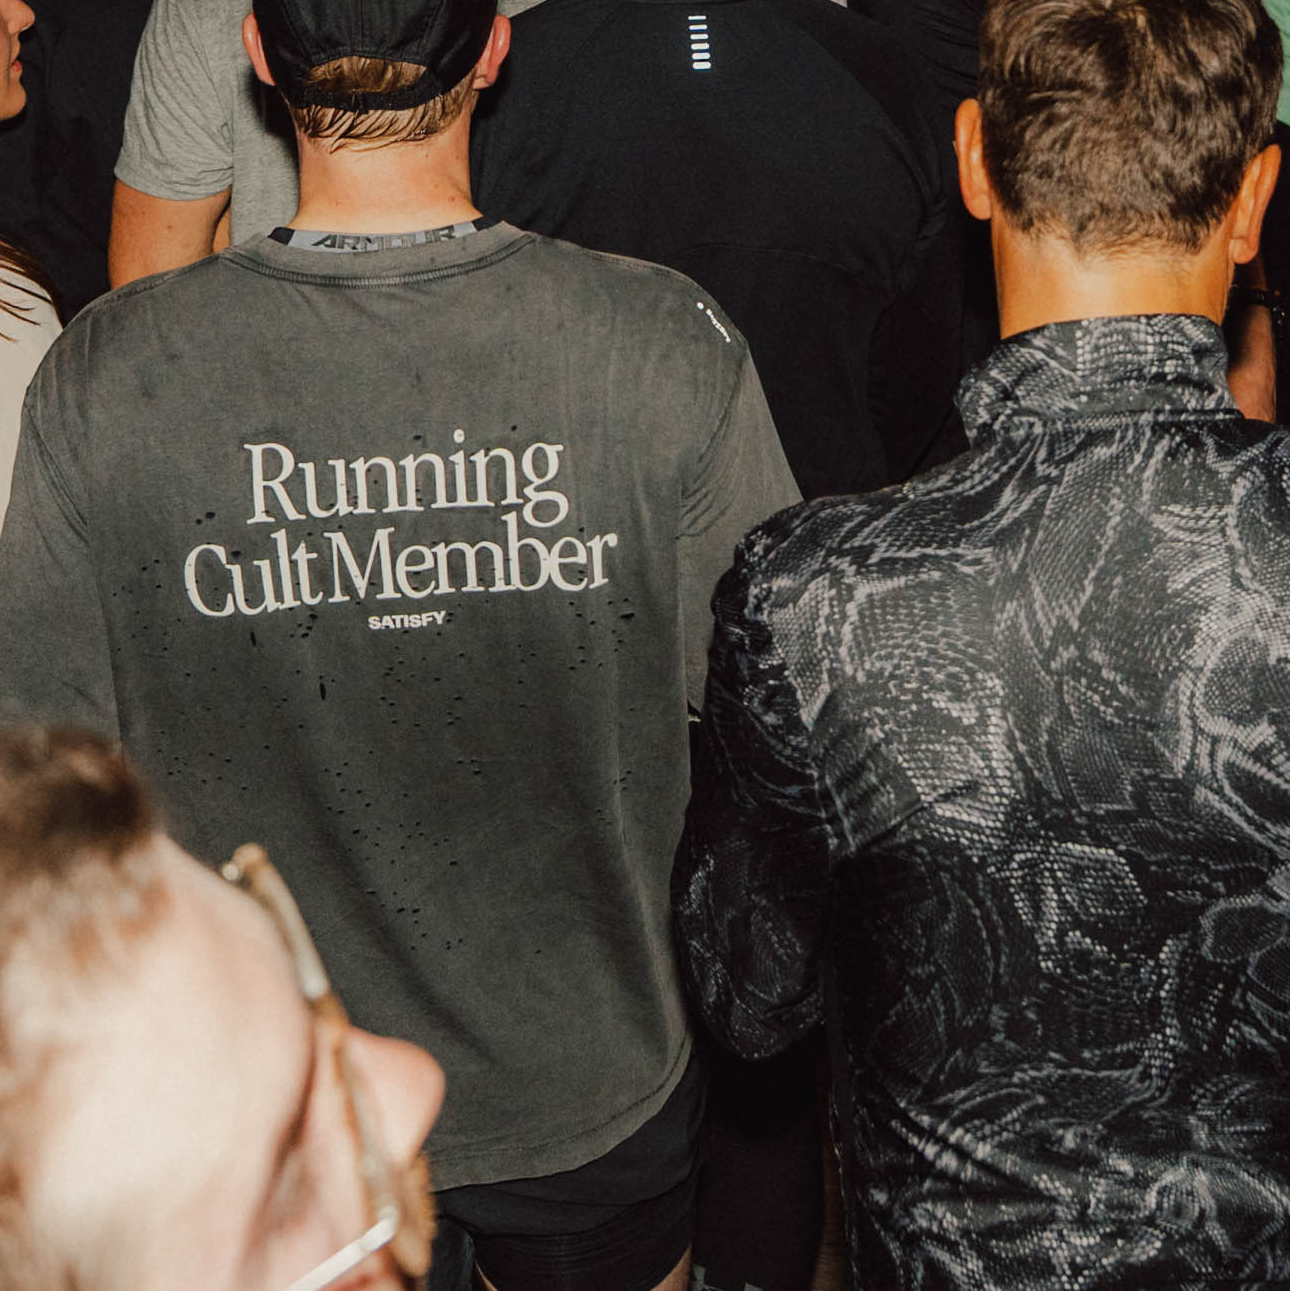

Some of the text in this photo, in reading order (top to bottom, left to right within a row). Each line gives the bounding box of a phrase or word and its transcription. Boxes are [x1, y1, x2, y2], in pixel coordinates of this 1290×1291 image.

[244, 429, 568, 527] Running
[184, 511, 618, 618] Cult Member
[368, 610, 448, 631] SATISFY
